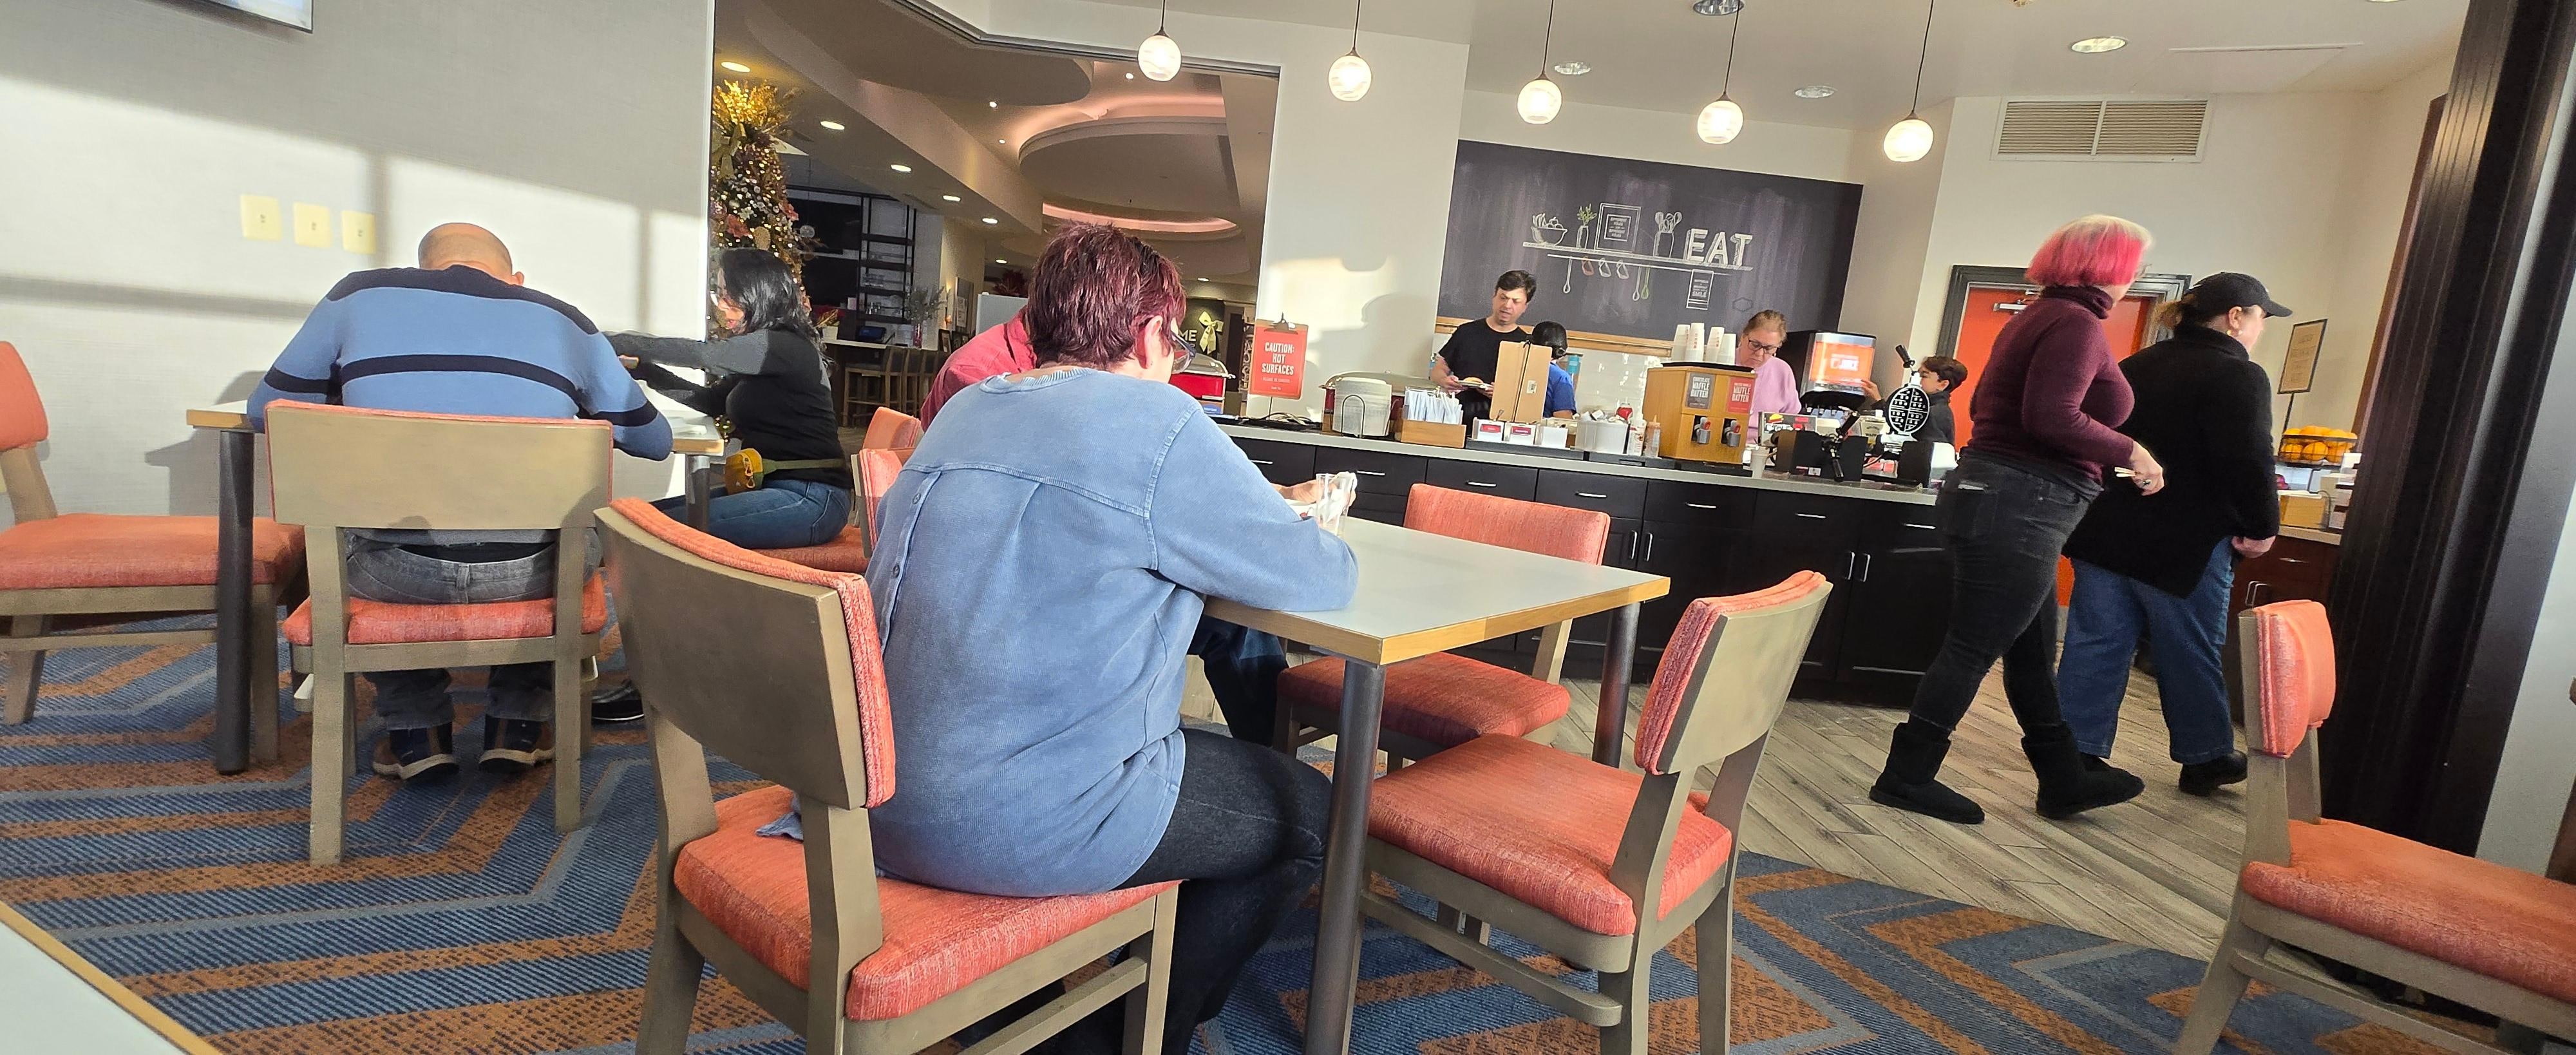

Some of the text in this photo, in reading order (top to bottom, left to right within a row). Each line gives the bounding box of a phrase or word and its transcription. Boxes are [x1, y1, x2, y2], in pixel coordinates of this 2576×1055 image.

[1683, 228, 1753, 268] EAT
[1179, 329, 1197, 341] ME
[1264, 341, 1294, 354] CAUTION:
[1272, 353, 1285, 364] HOT
[1262, 363, 1294, 375] SURFACES
[1692, 382, 1710, 390] WAFFLE
[1733, 386, 1751, 395] WAFFLE
[1690, 389, 1709, 397] BATTER
[1731, 394, 1749, 403] BATTER
